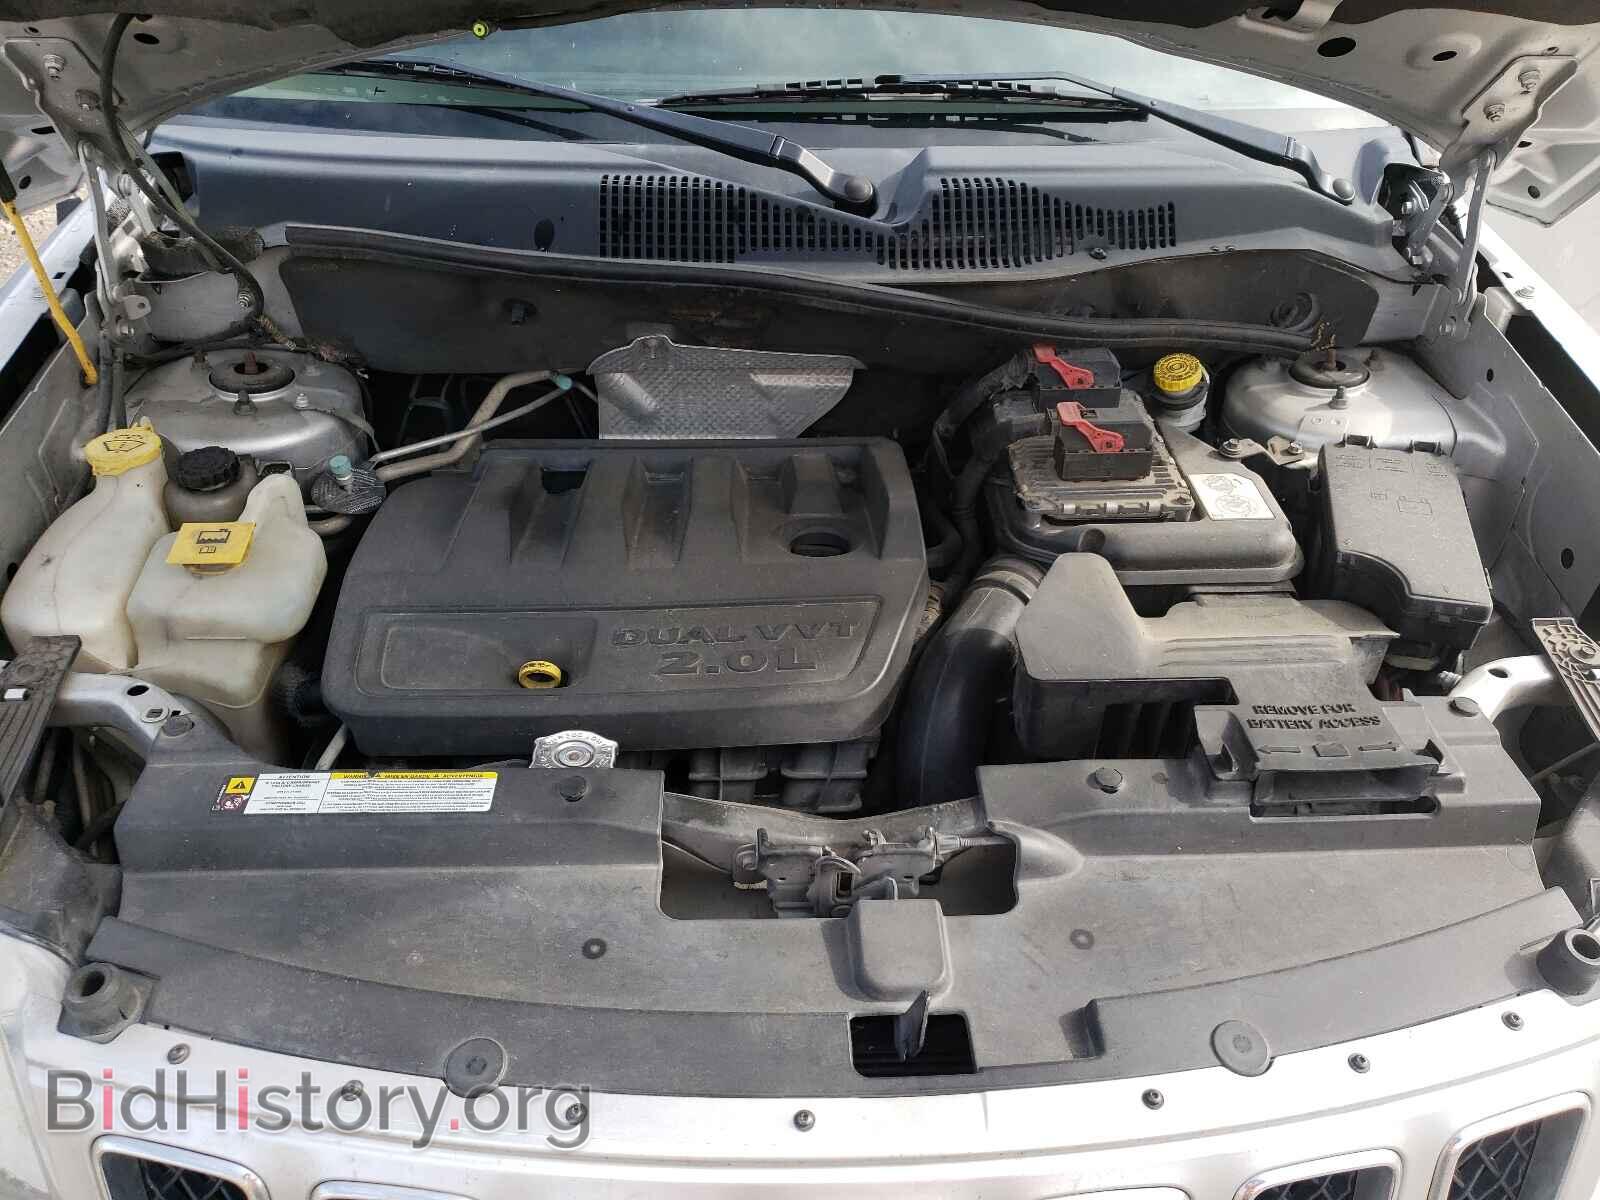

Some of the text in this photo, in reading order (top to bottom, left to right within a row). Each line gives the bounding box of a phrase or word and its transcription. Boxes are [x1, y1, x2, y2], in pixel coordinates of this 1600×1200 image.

[613, 622, 857, 647] DUAL VVT
[655, 648, 817, 676] 2.0L
[1252, 703, 1356, 716] REMOVE FOR
[1246, 716, 1381, 730] BATTERY ACCESS
